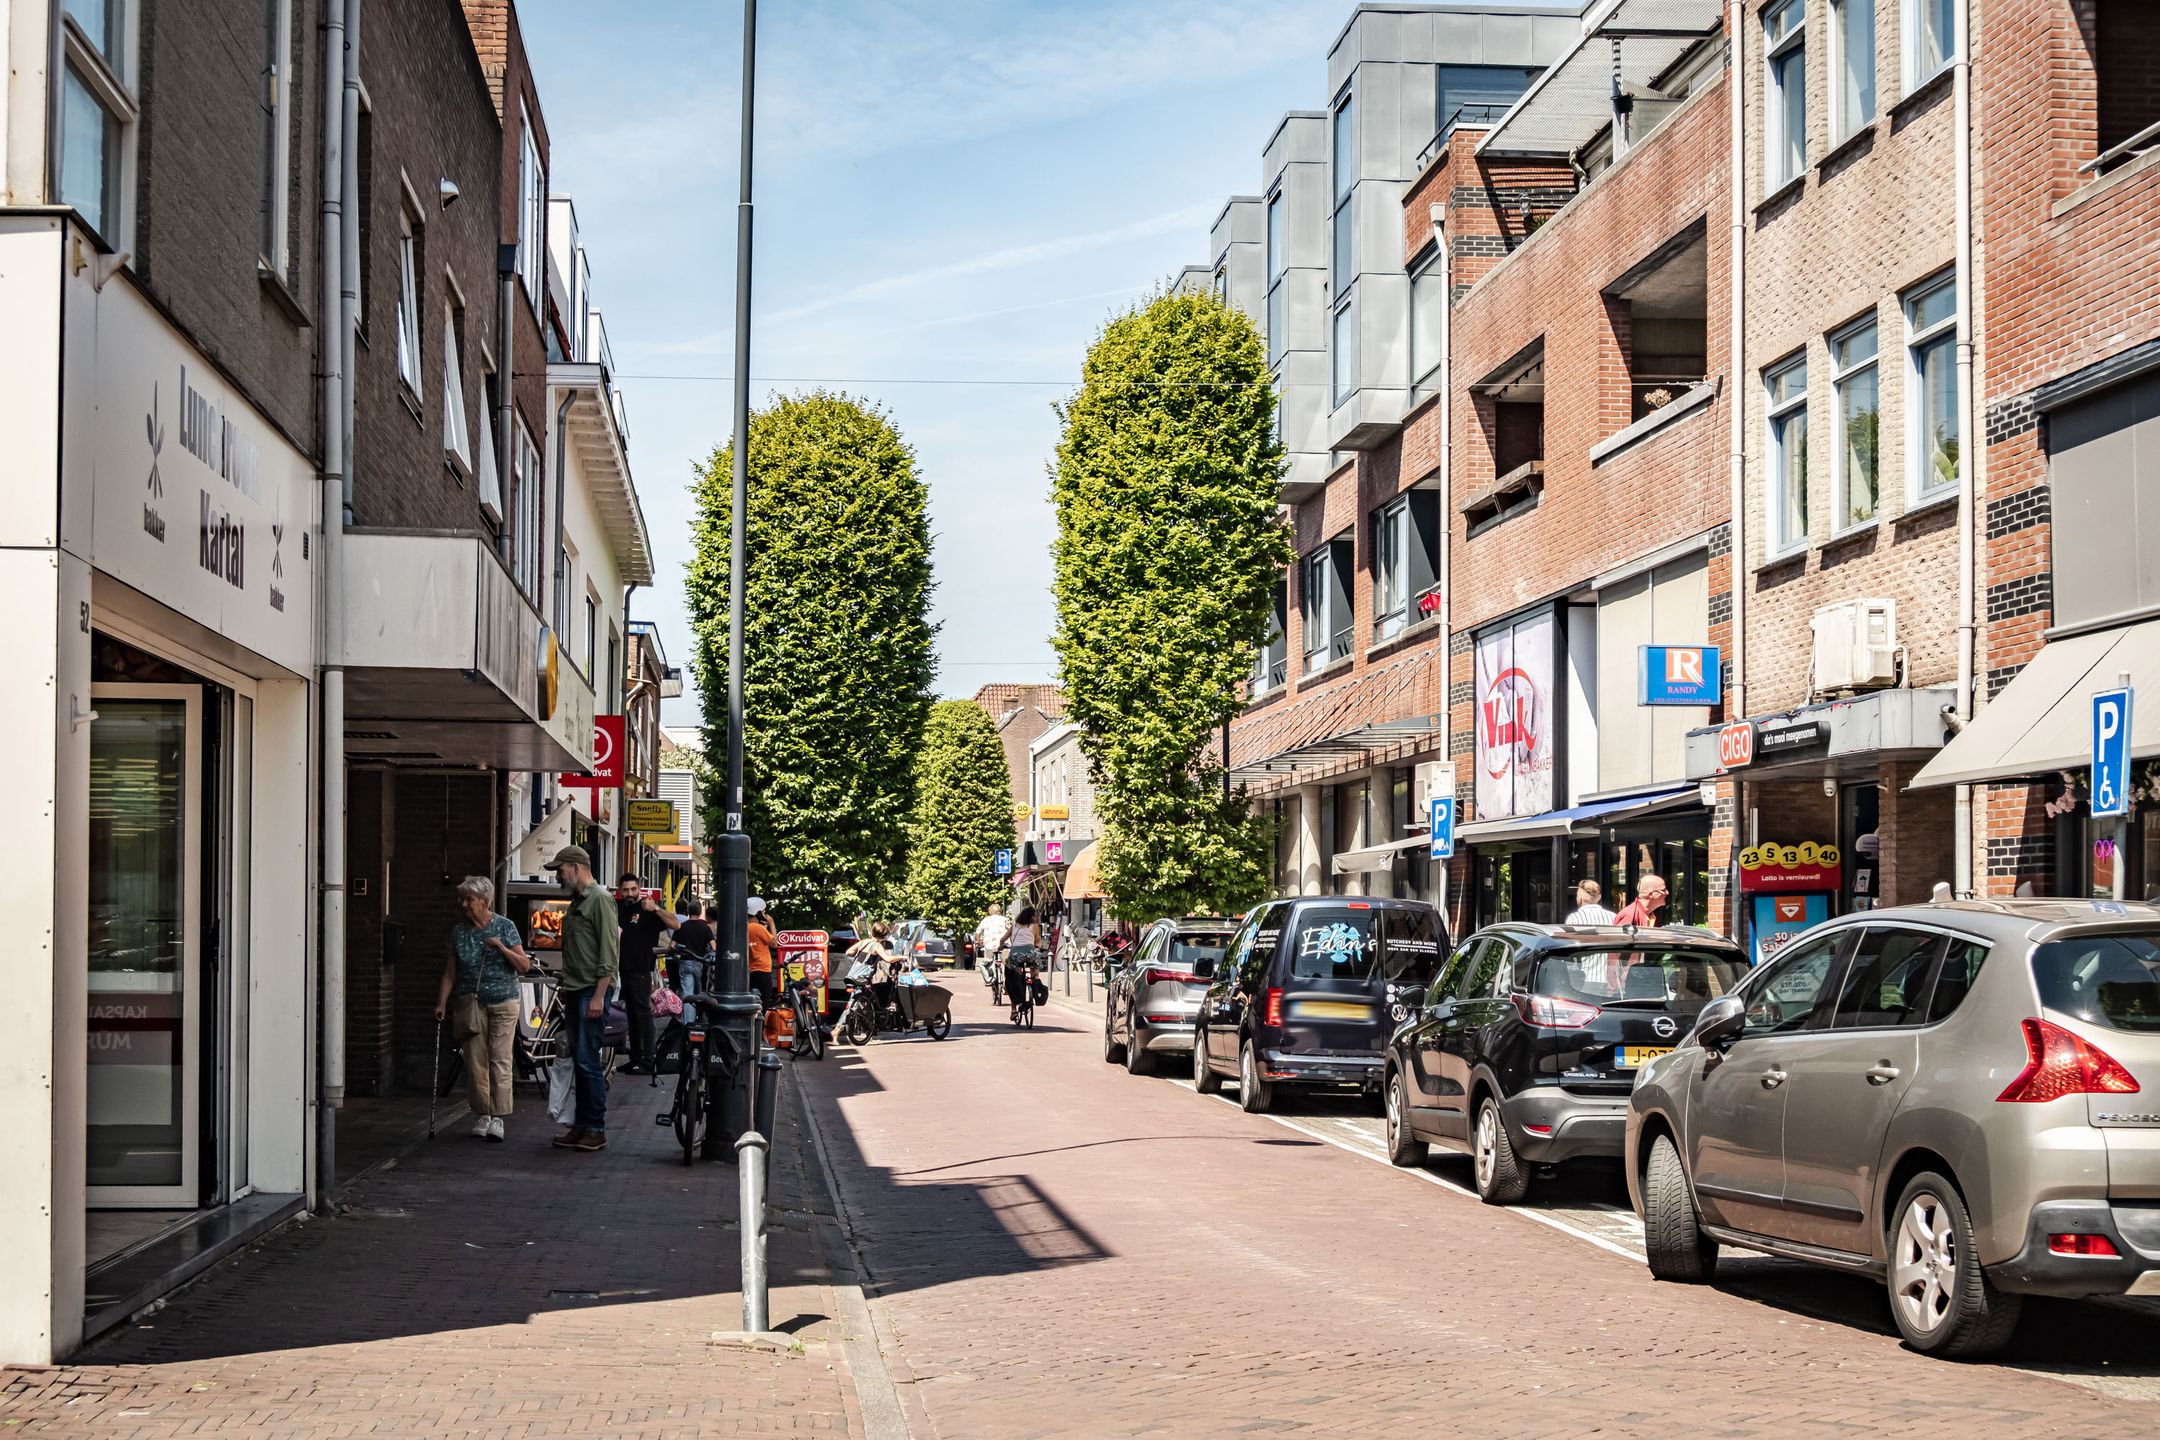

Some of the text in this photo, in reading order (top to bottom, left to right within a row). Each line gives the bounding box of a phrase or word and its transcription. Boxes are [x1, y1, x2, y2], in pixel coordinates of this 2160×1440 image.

[143, 502, 166, 544] bakker
[199, 488, 244, 590] Kartal
[80, 600, 90, 634] 52
[1667, 686, 1698, 694] RANDY
[1764, 727, 1817, 746] da's mooi meegenomen
[2098, 701, 2119, 763] P
[1721, 729, 1750, 762] CIGO
[1435, 803, 1447, 833] P
[998, 852, 1007, 864] P
[1047, 845, 1061, 859] da
[1742, 851, 1759, 865] 23
[1766, 848, 1775, 859] 5
[1782, 851, 1797, 862] 13
[1820, 850, 1838, 862] 40
[2094, 839, 2115, 864] ope
[790, 933, 824, 942] Kruidvat
[1301, 926, 1377, 957] Edin's
[1774, 931, 1787, 942] 30
[805, 963, 822, 973] 2+2
[2098, 1113, 2160, 1123] PEUGEO
